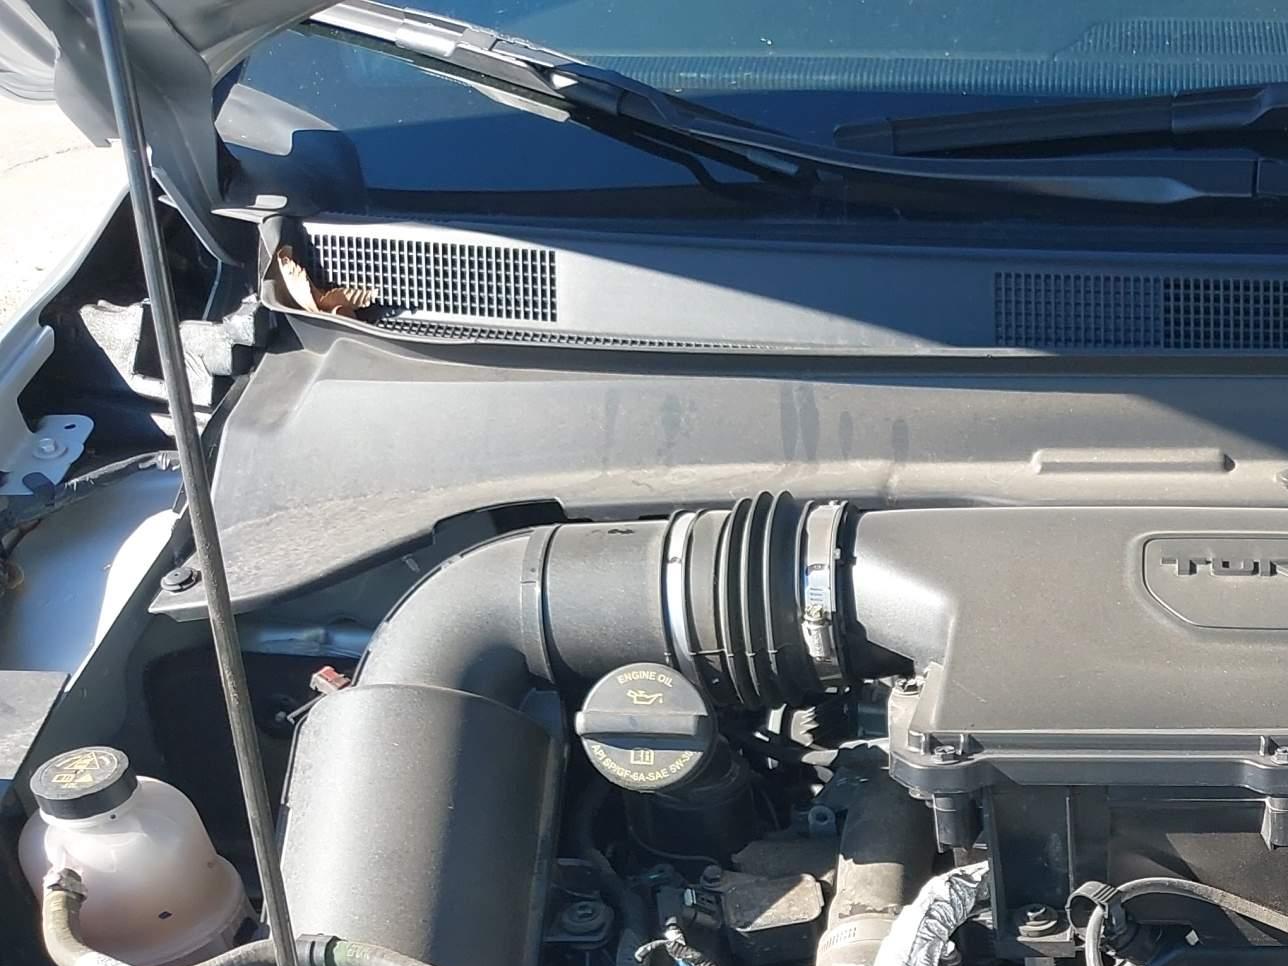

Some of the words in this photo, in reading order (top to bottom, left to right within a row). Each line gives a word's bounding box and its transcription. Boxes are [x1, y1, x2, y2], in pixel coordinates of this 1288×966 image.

[617, 671, 657, 684] ENGINE
[657, 674, 674, 688] OIL
[591, 744, 607, 762] API
